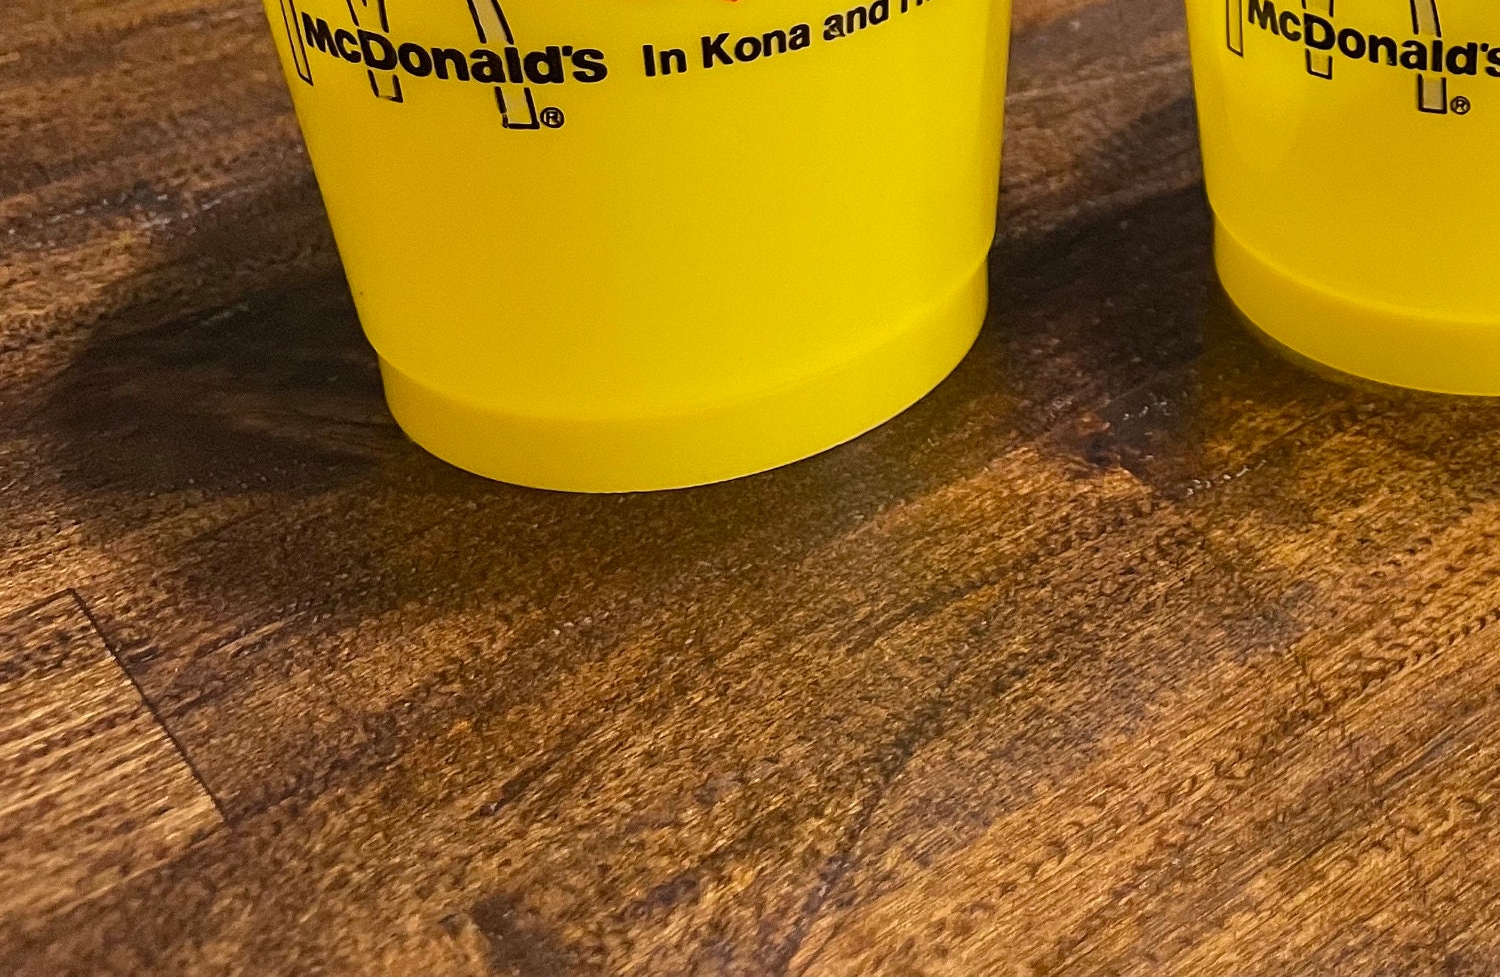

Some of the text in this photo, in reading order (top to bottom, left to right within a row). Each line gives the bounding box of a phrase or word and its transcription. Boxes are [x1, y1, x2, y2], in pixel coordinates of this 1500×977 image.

[301, 11, 608, 84] McDonald's
[642, 44, 688, 78] In
[700, 23, 811, 69] Kona
